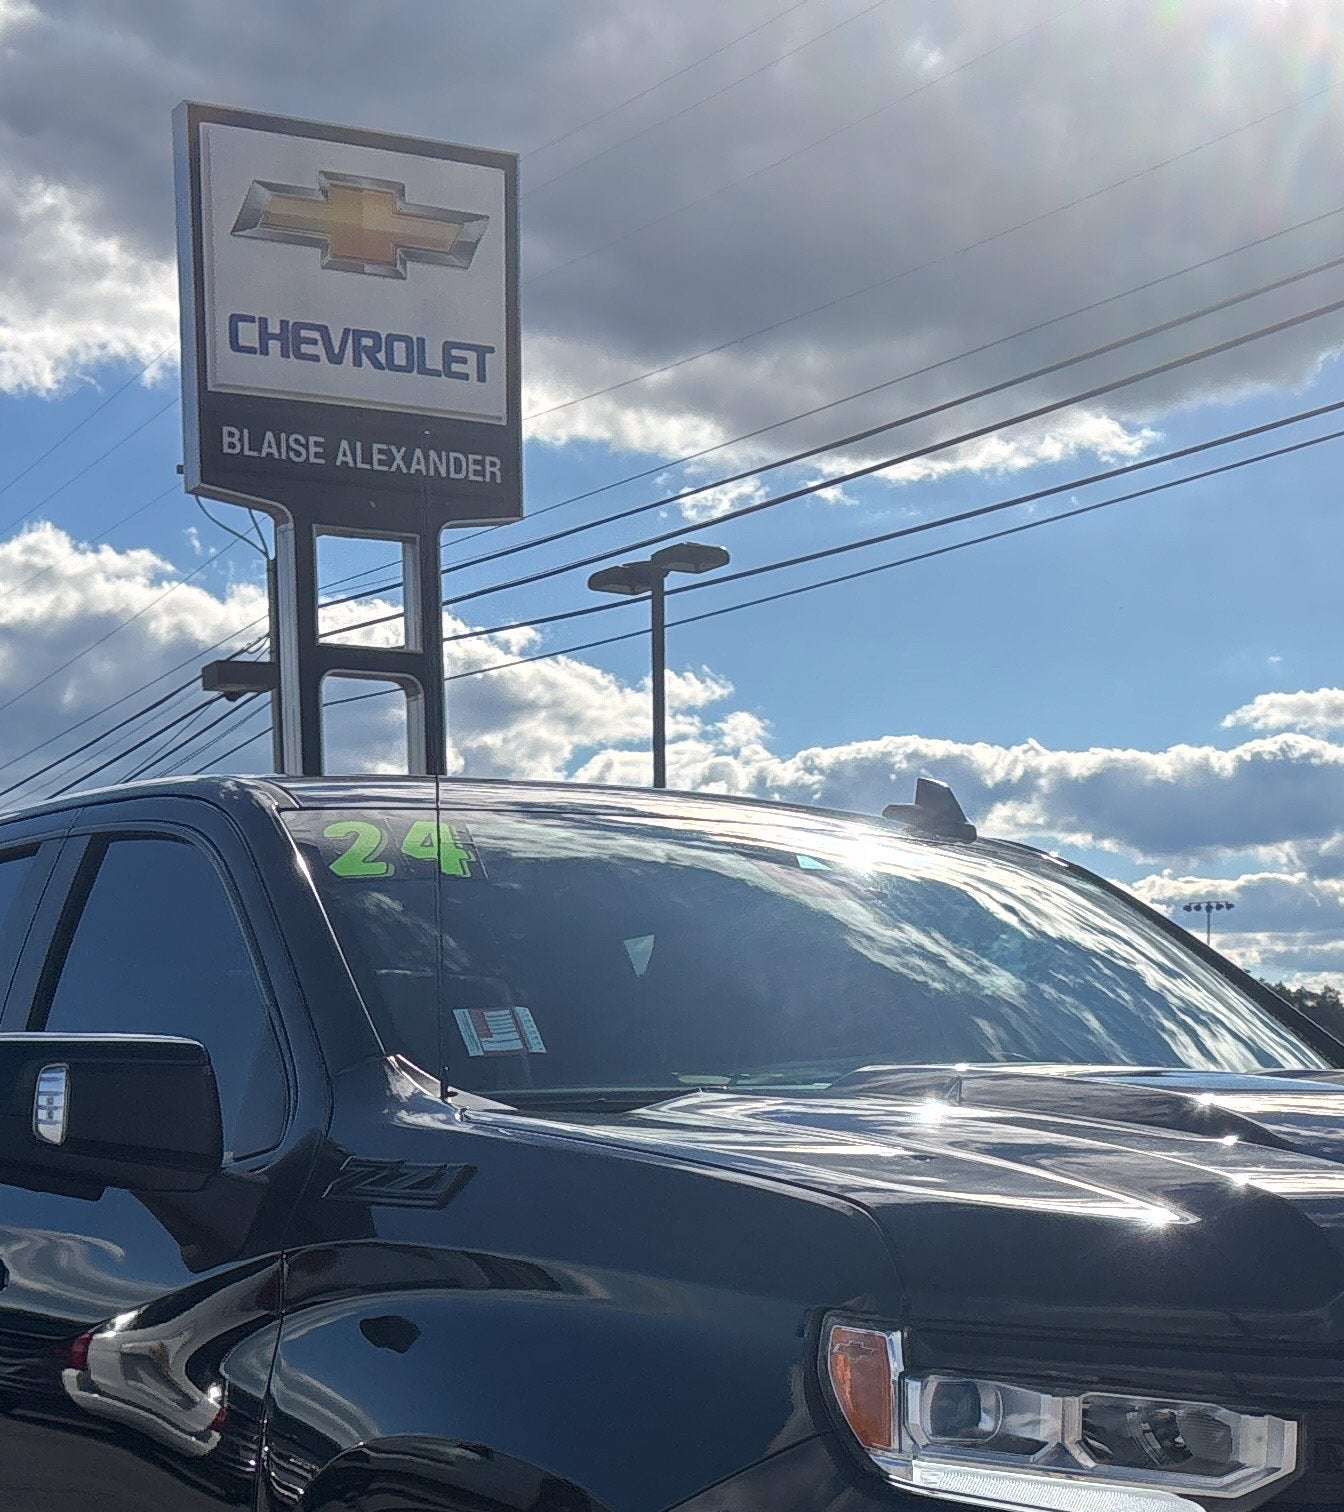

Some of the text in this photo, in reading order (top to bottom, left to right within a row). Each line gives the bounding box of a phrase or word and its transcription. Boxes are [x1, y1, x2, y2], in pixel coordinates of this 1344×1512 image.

[229, 314, 495, 383] CHEVROLET
[222, 426, 503, 485] BLAISE ALEXANDER
[323, 820, 475, 878] 24
